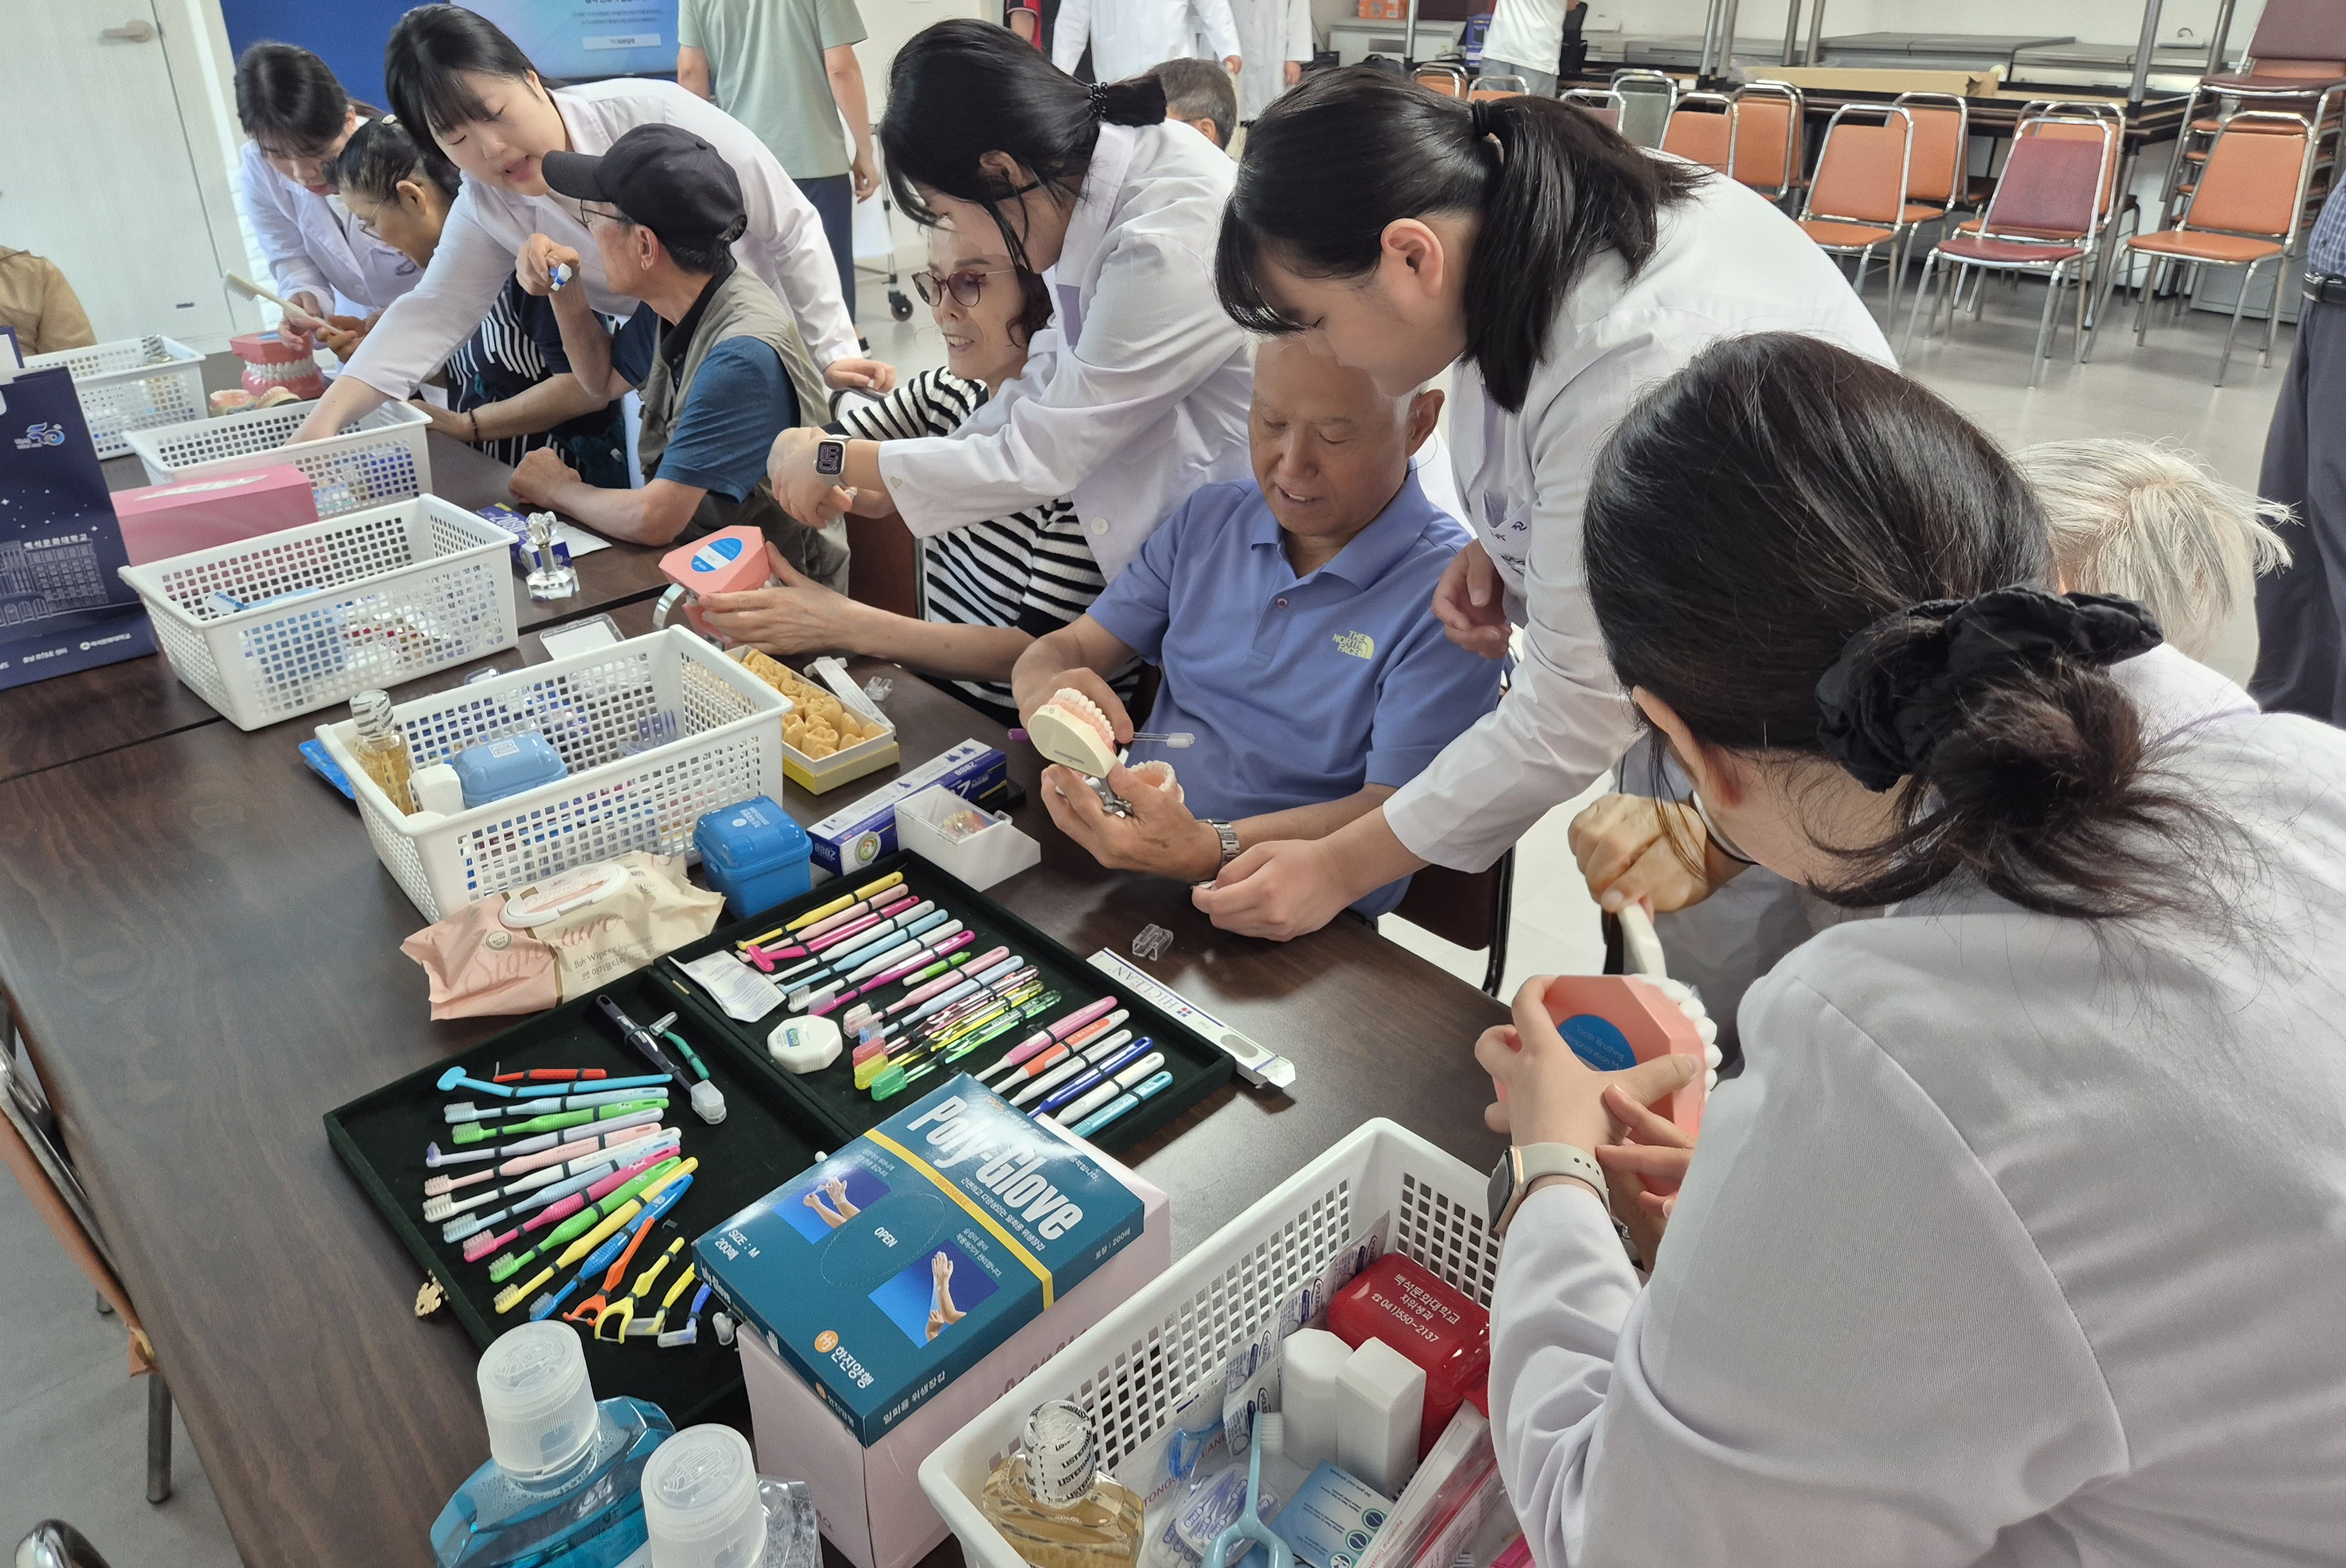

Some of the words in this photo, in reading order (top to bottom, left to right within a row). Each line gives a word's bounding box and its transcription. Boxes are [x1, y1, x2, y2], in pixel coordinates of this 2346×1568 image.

[1332, 633, 1363, 649] NORTH
[1337, 643, 1359, 657] FACE
[1349, 630, 1365, 642] THE
[954, 761, 978, 776] 2080
[814, 842, 837, 861] 2080
[465, 913, 624, 993] Signture
[587, 948, 612, 962] Wipes
[1112, 965, 1179, 1009] HICLEAN
[1576, 1024, 1595, 1042] Tooth
[1595, 1037, 1625, 1062] Brushing
[906, 1094, 1083, 1240] Poly-Glove
[933, 1175, 970, 1208] DISPOSABLE
[960, 1176, 984, 1197] 간편하고
[1005, 1214, 1024, 1232] 일회용
[1021, 1228, 1046, 1252] 위생장갑
[728, 1228, 749, 1247] SIZE
[748, 1247, 760, 1258] M
[874, 1226, 898, 1248] OPEN
[1394, 1273, 1461, 1325] 백석문화대학교
[1379, 1299, 1440, 1343] 041)550-2137
[830, 1345, 875, 1388] 한진양행
[883, 1399, 910, 1426] 일회용
[911, 1369, 946, 1403] 위생장갑
[1143, 1473, 1182, 1507] TONGU
